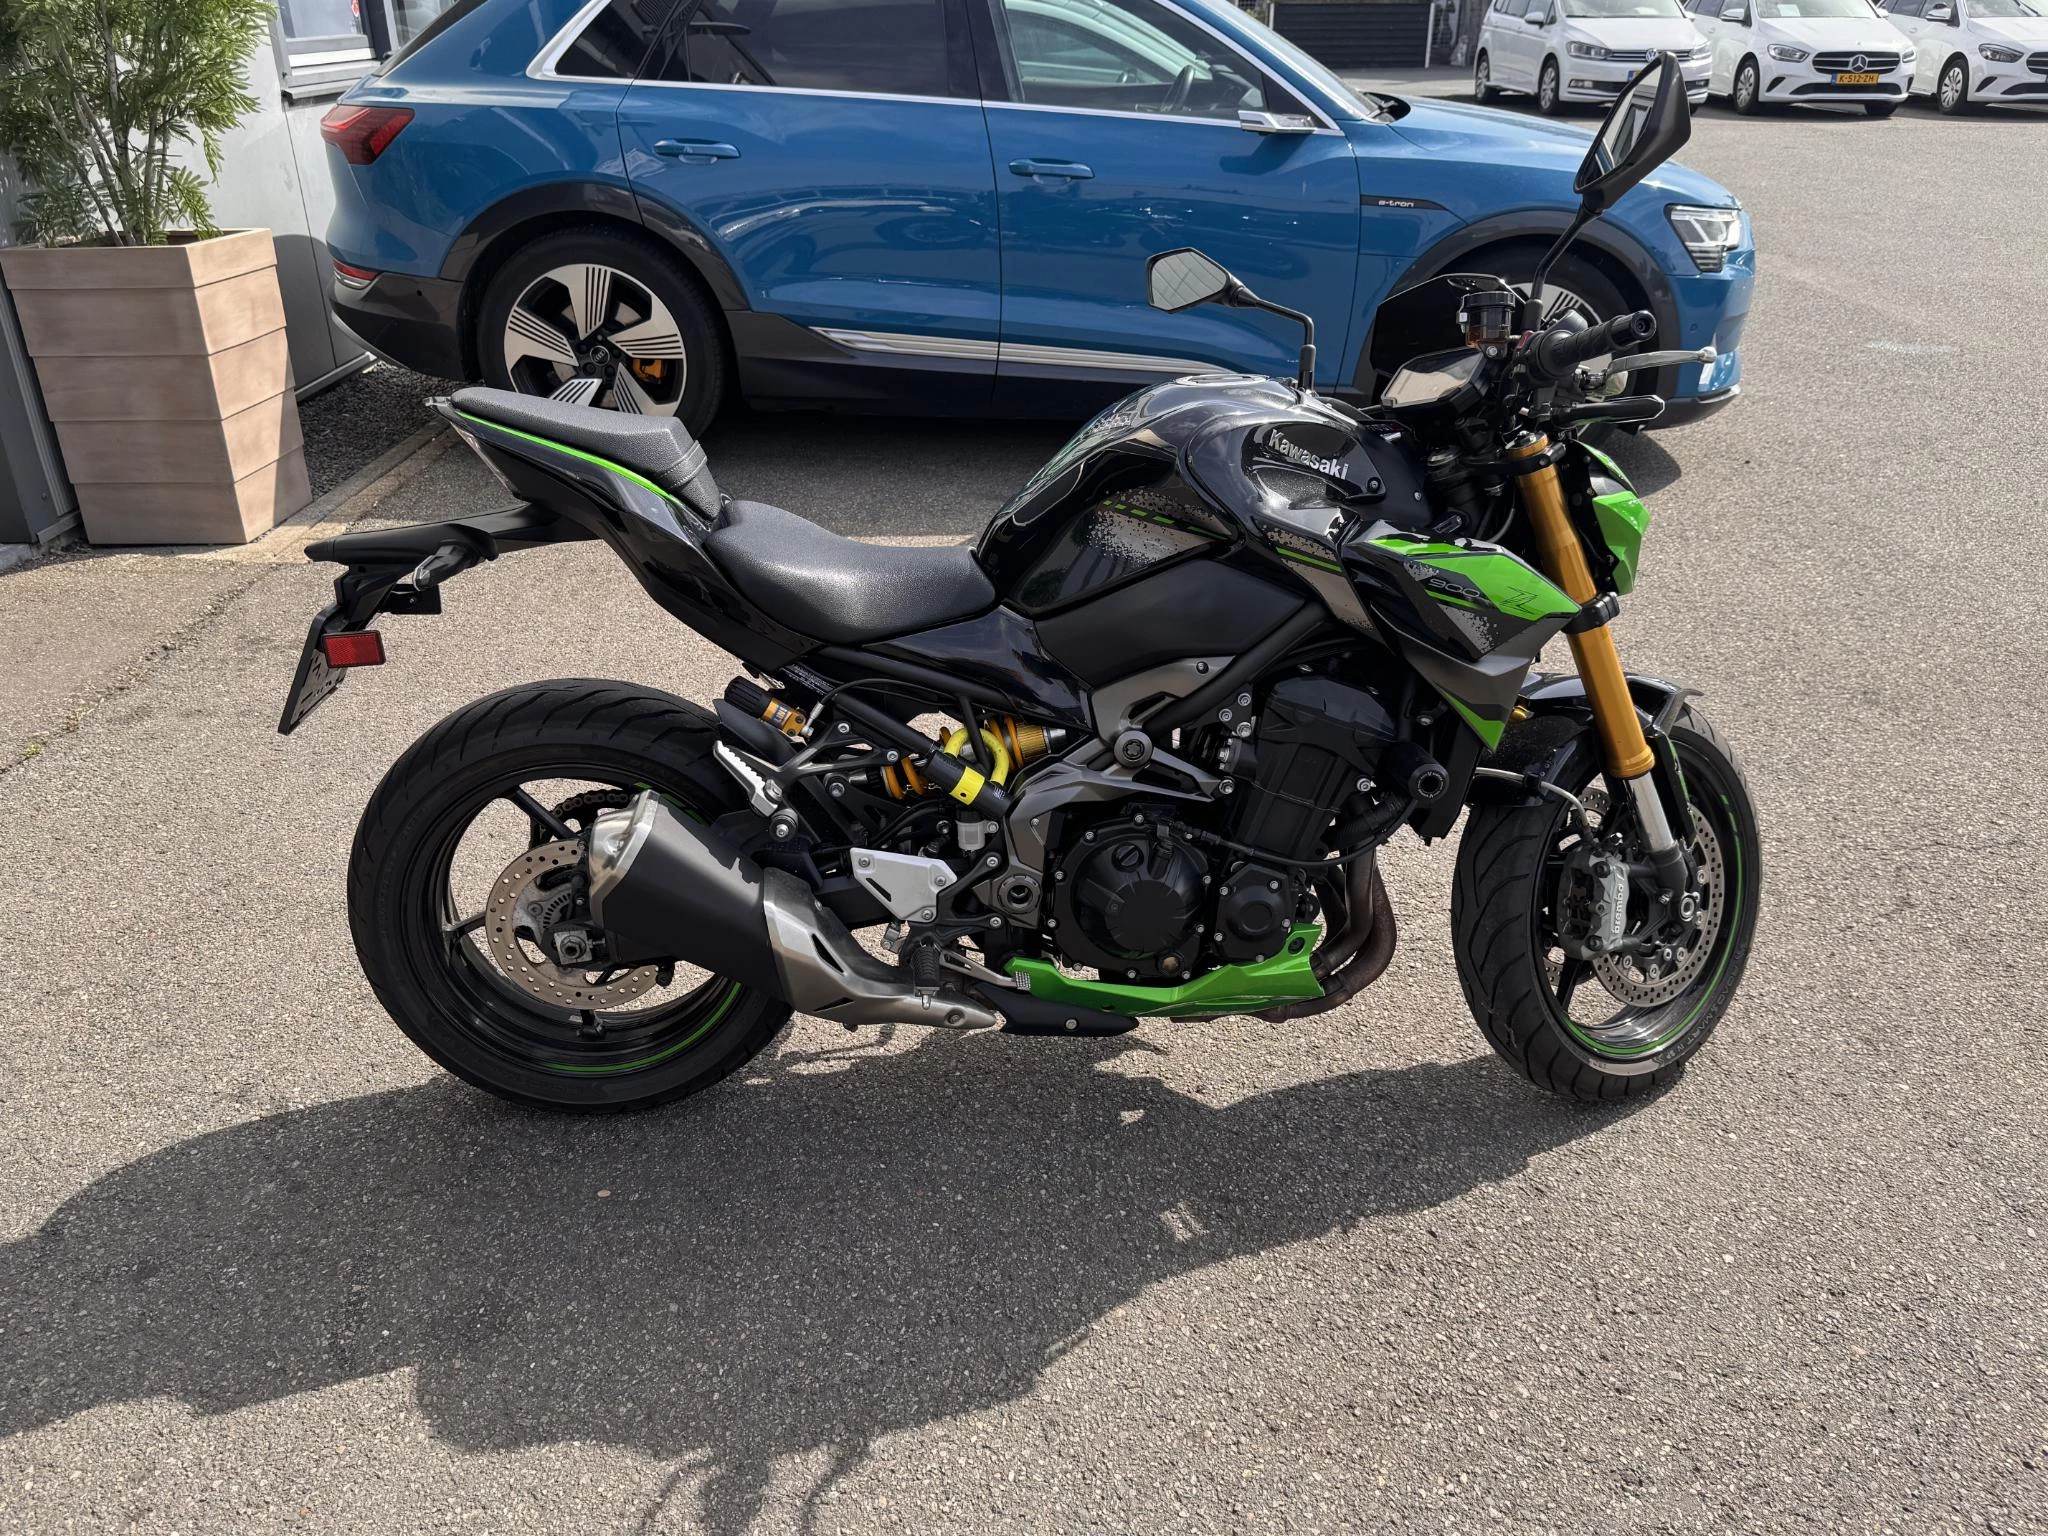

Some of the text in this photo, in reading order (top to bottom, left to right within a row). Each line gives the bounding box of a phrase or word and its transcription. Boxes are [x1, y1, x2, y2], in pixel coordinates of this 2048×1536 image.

[1268, 428, 1349, 480] Kawasaki
[1428, 578, 1481, 598] 900
[1612, 883, 1624, 934] brembo
